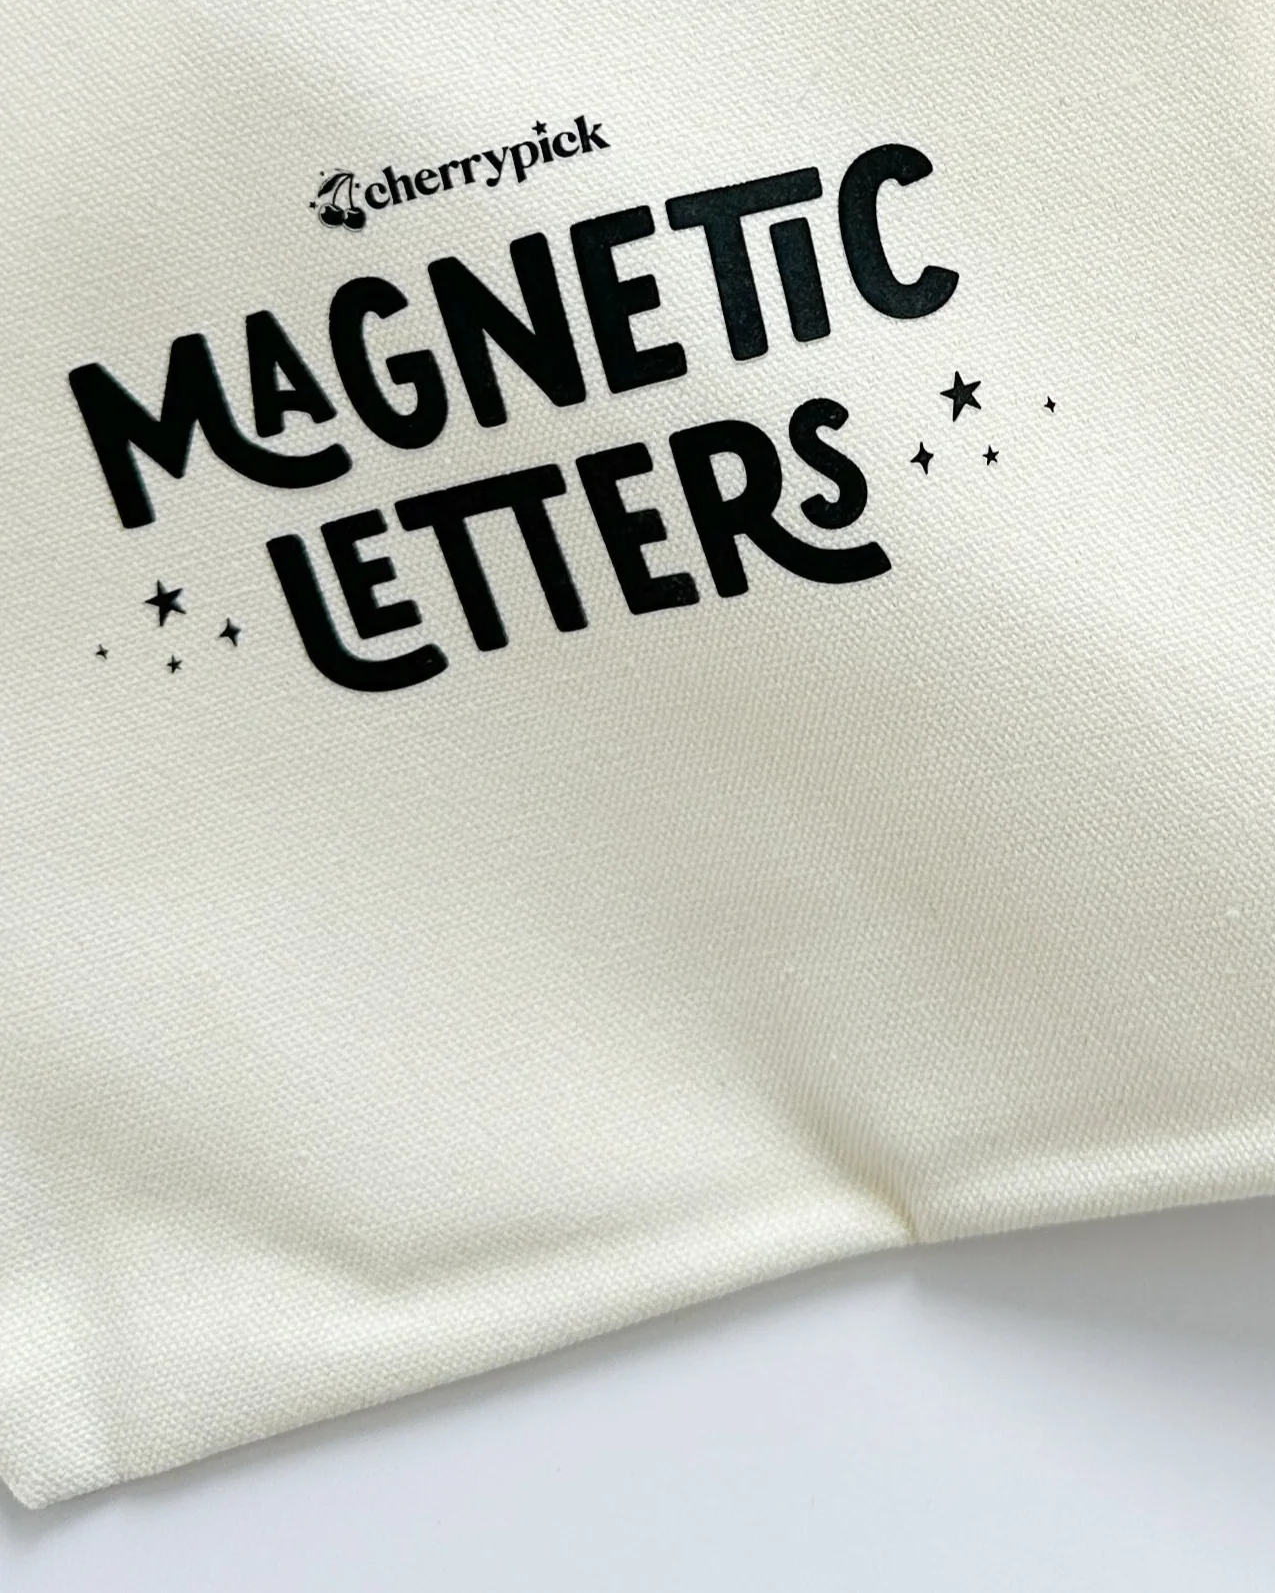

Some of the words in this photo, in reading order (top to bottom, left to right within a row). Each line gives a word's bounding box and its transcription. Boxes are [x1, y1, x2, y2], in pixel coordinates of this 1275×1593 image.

[364, 115, 611, 211] cherrypick
[68, 143, 960, 530] MAGNETIC
[265, 397, 892, 693] LETTERS
